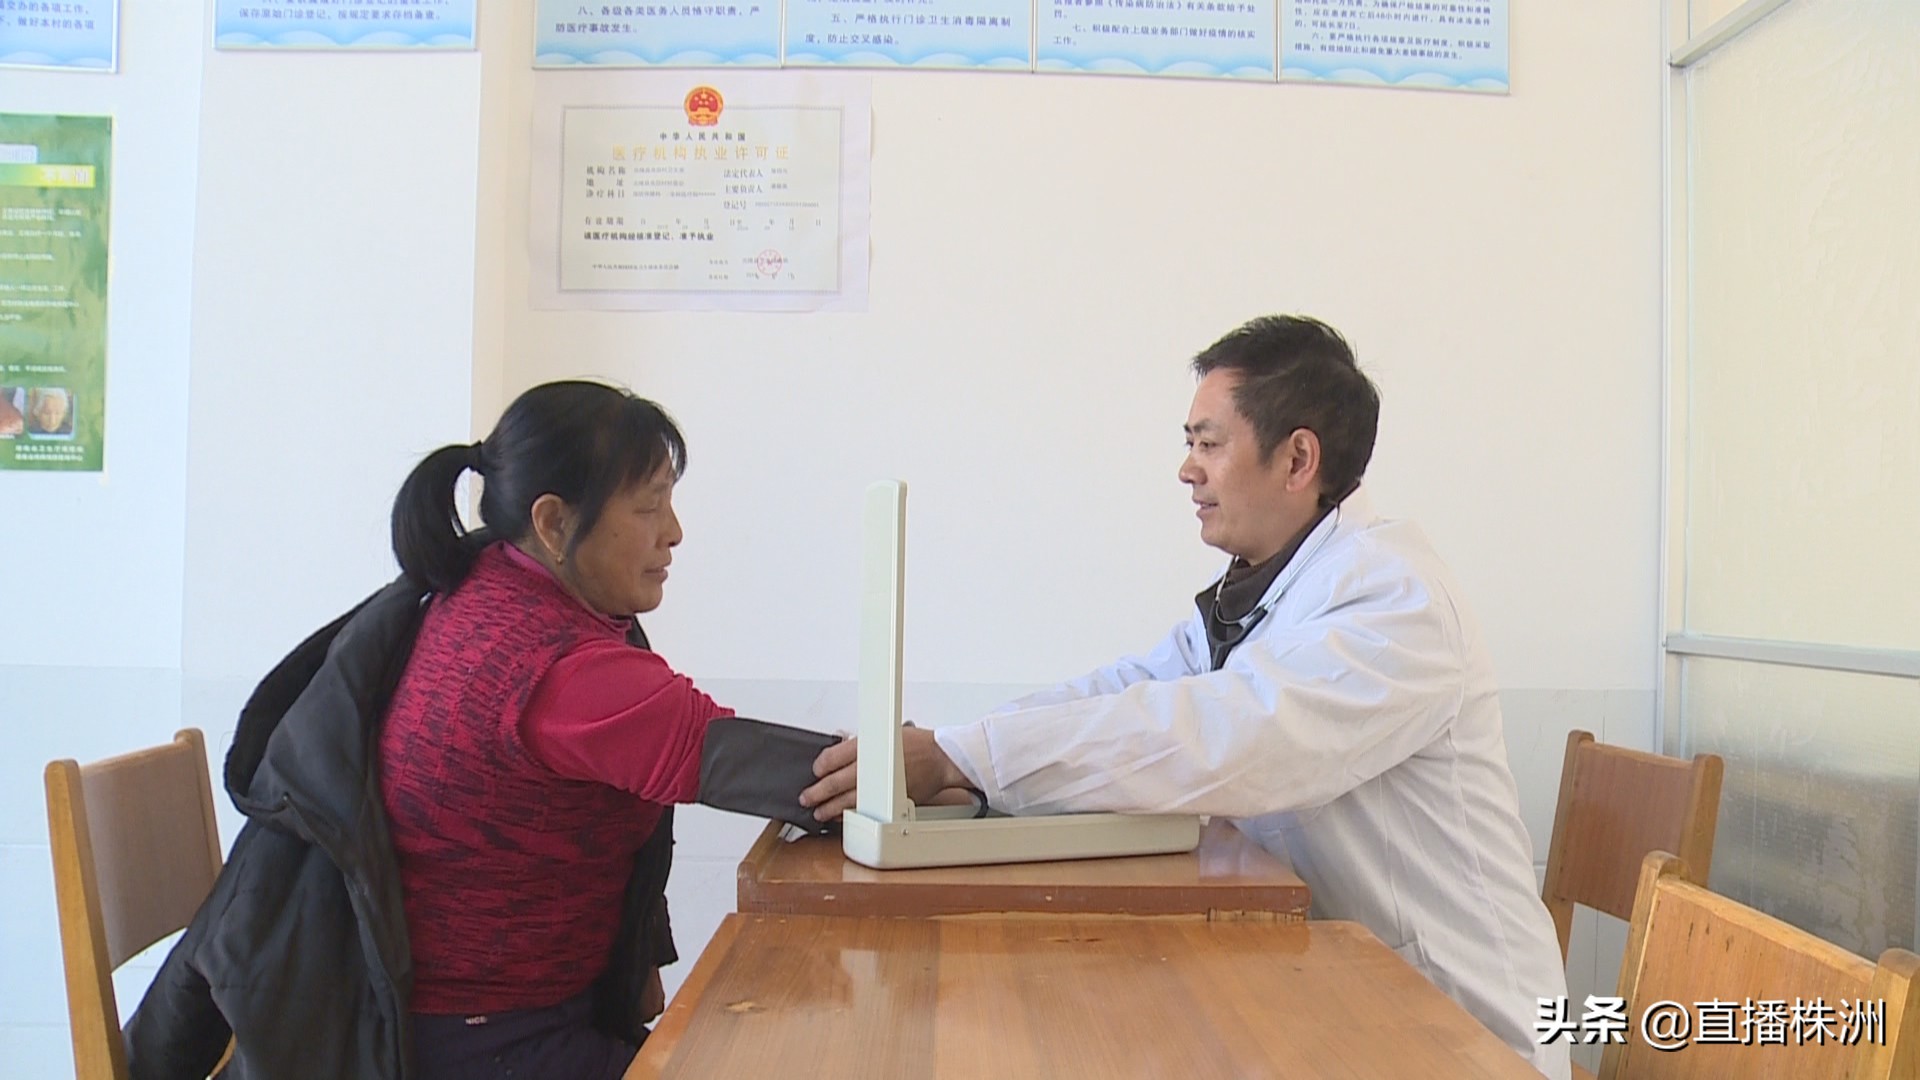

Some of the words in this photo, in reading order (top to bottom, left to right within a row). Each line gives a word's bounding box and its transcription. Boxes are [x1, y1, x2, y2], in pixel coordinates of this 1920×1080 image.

[831, 13, 1011, 27] 五、严格执行门诊卫生消毒隔离制
[805, 33, 900, 45] 度，防止交叉感染。
[1053, 36, 1077, 46] 工作。
[660, 131, 746, 142] 中华人民共和国
[612, 143, 790, 161] 医疗机构执业许可证
[586, 166, 626, 176] 机构名称
[723, 168, 764, 178] 法定代表人
[724, 183, 763, 194] 主要负责人
